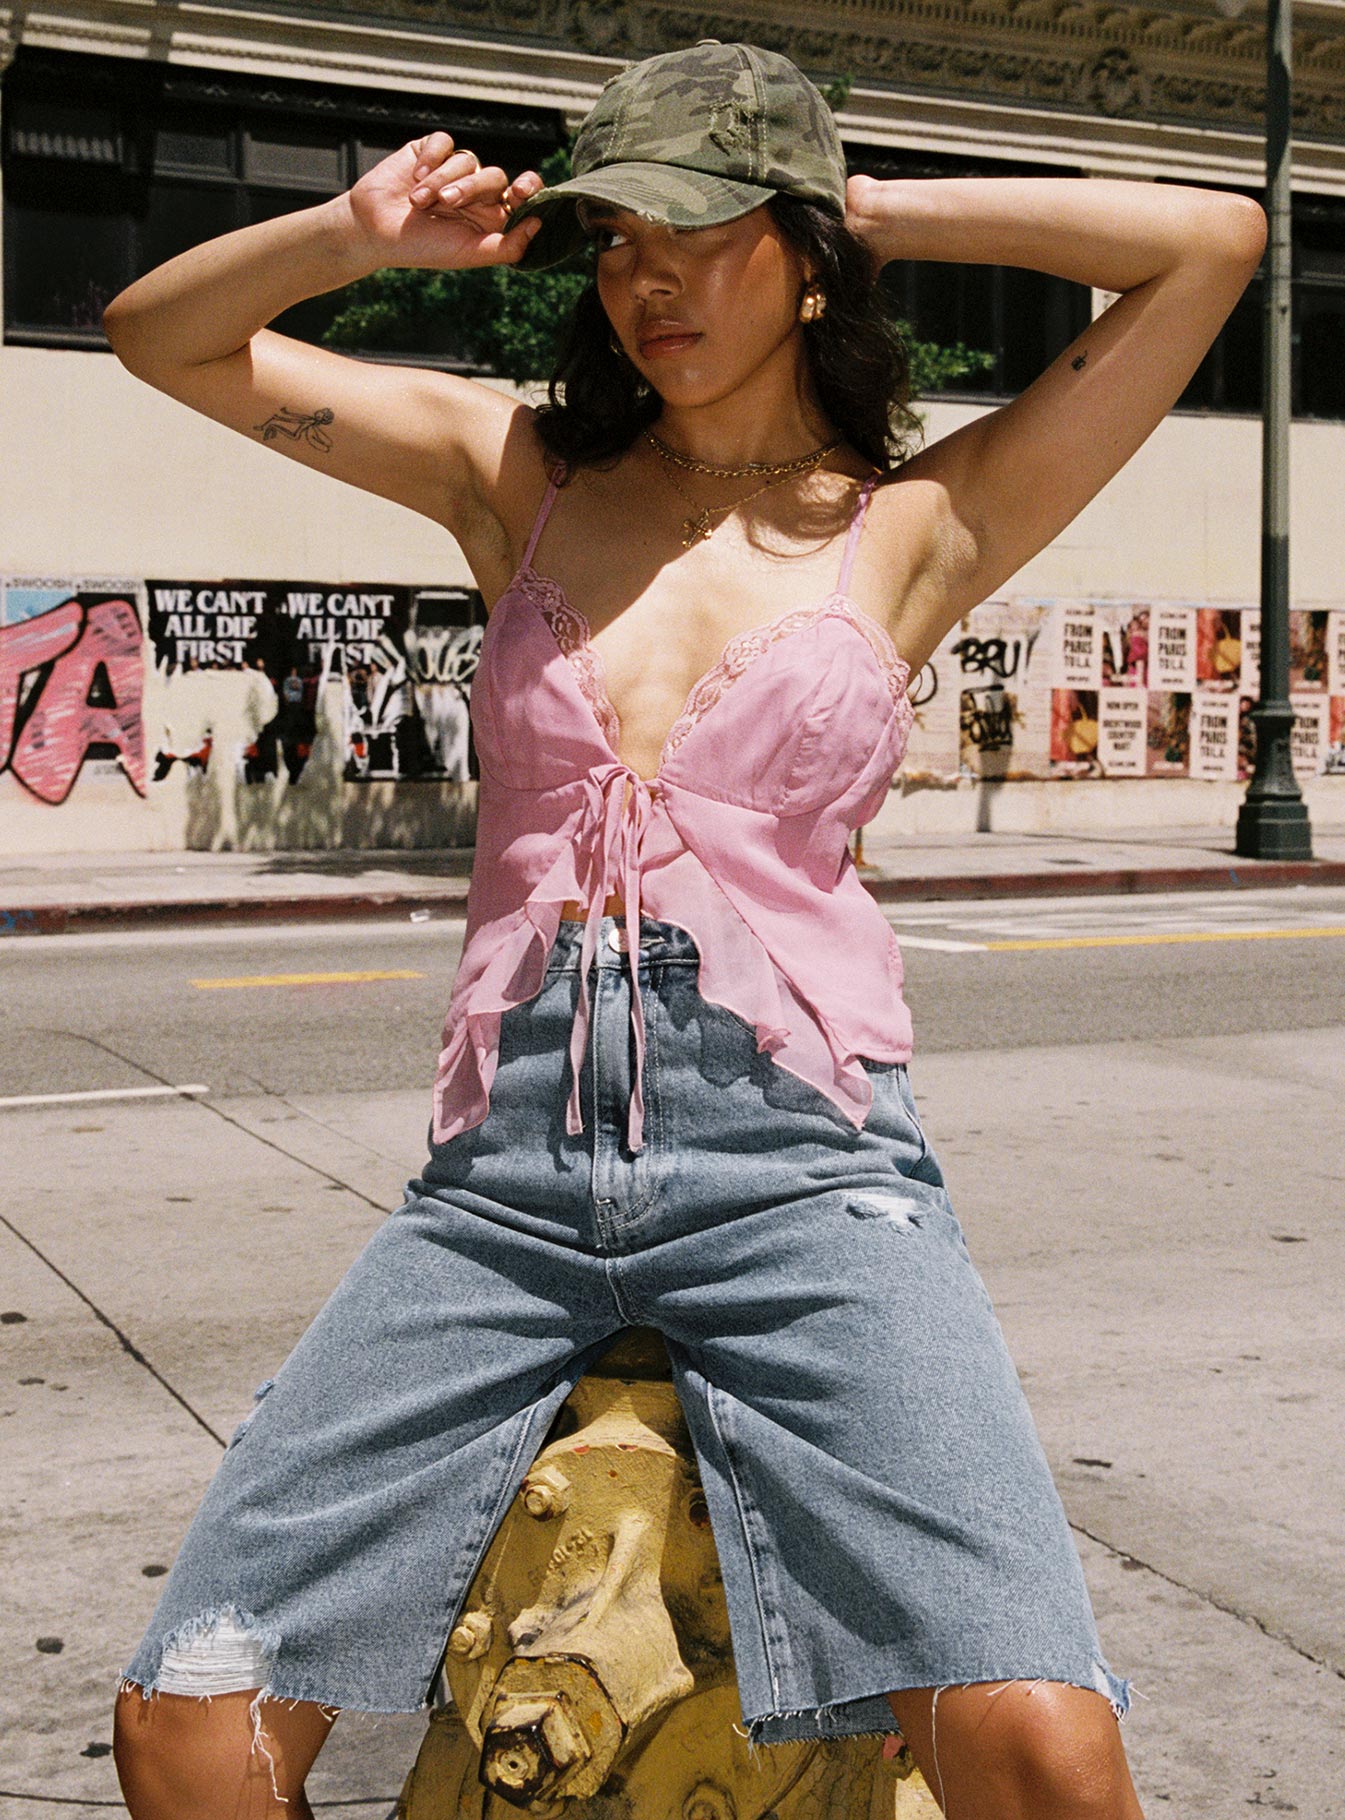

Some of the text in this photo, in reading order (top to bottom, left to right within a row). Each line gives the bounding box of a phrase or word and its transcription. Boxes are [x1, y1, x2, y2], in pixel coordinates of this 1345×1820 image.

[154, 589, 194, 613] WE
[287, 592, 325, 617] WE
[164, 614, 258, 639] ALL DIE
[296, 617, 385, 640] ALL DIE
[1064, 624, 1093, 638] FROM
[1159, 627, 1187, 641] FROM
[176, 640, 247, 664] FIRST
[1063, 640, 1092, 654] PARIS
[1158, 642, 1187, 656] PARIS
[1201, 715, 1227, 728] FROM
[1200, 731, 1227, 744] PARIS
